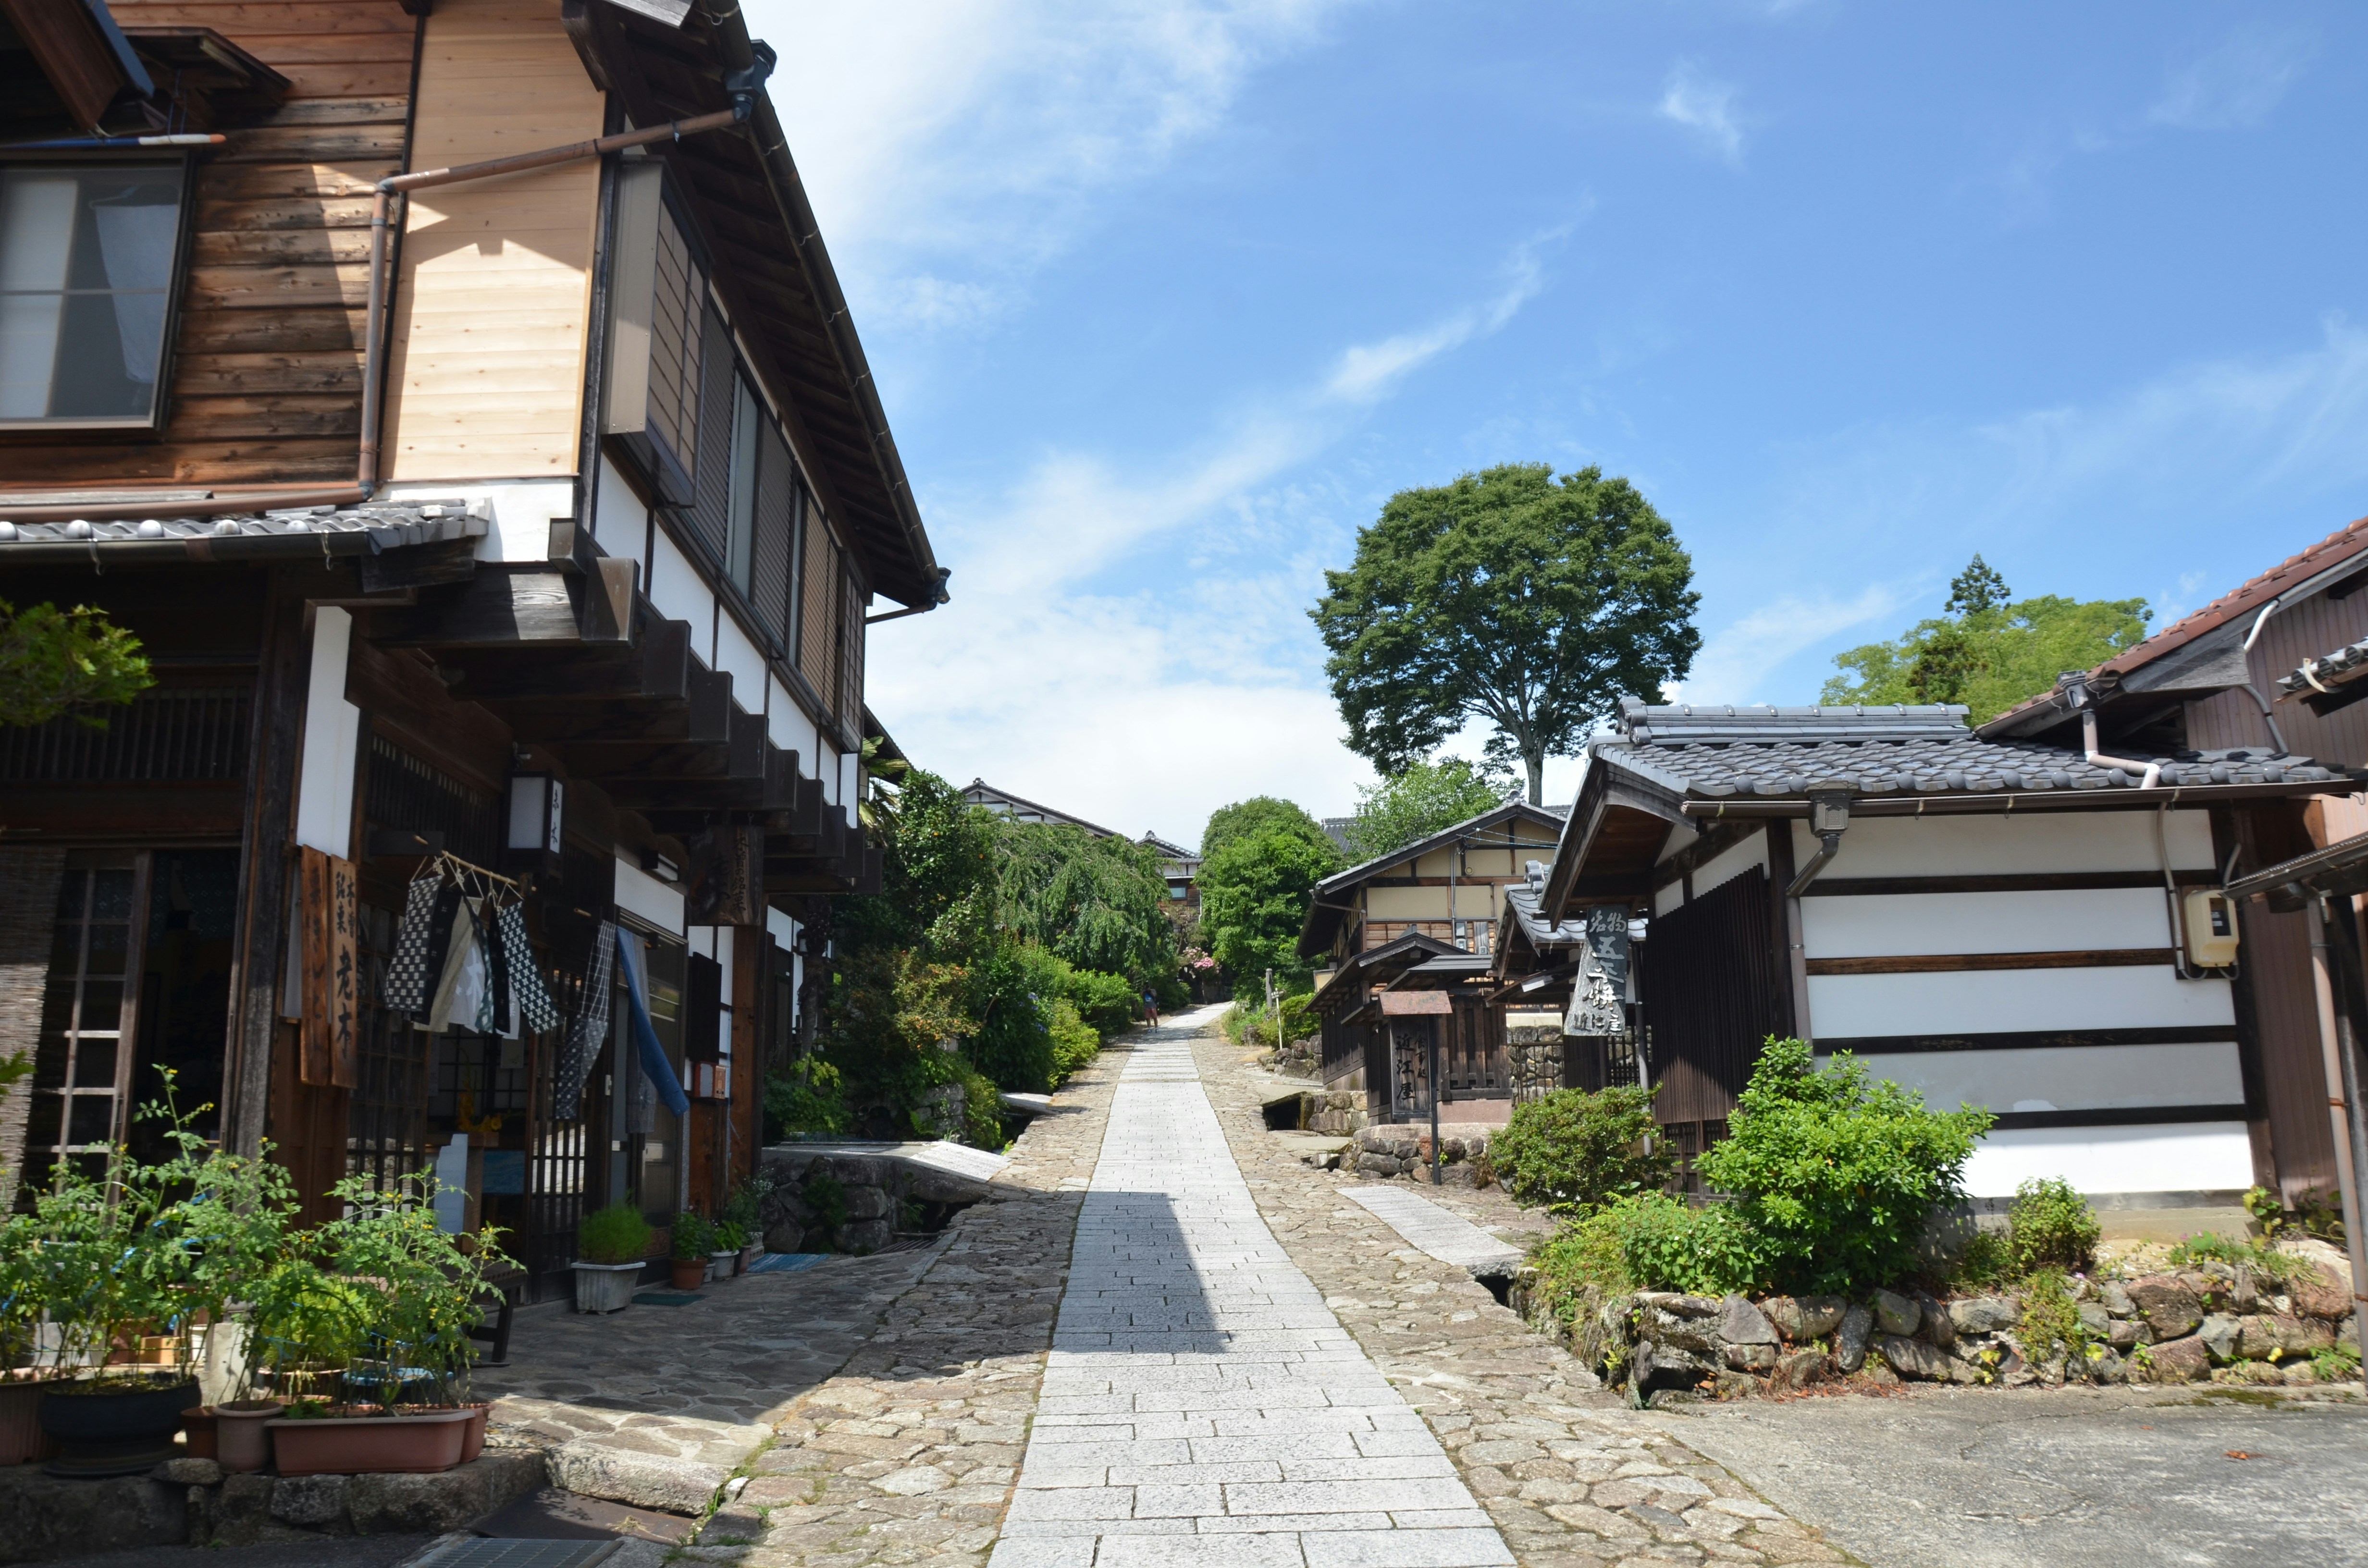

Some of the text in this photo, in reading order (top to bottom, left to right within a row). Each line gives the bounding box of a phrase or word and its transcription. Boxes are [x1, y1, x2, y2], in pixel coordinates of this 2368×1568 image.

[335, 870, 347, 933] 銘菓
[1589, 910, 1627, 933] 名物
[1582, 936, 1625, 1011] 五平餅
[1396, 1034, 1416, 1101] 近江屋
